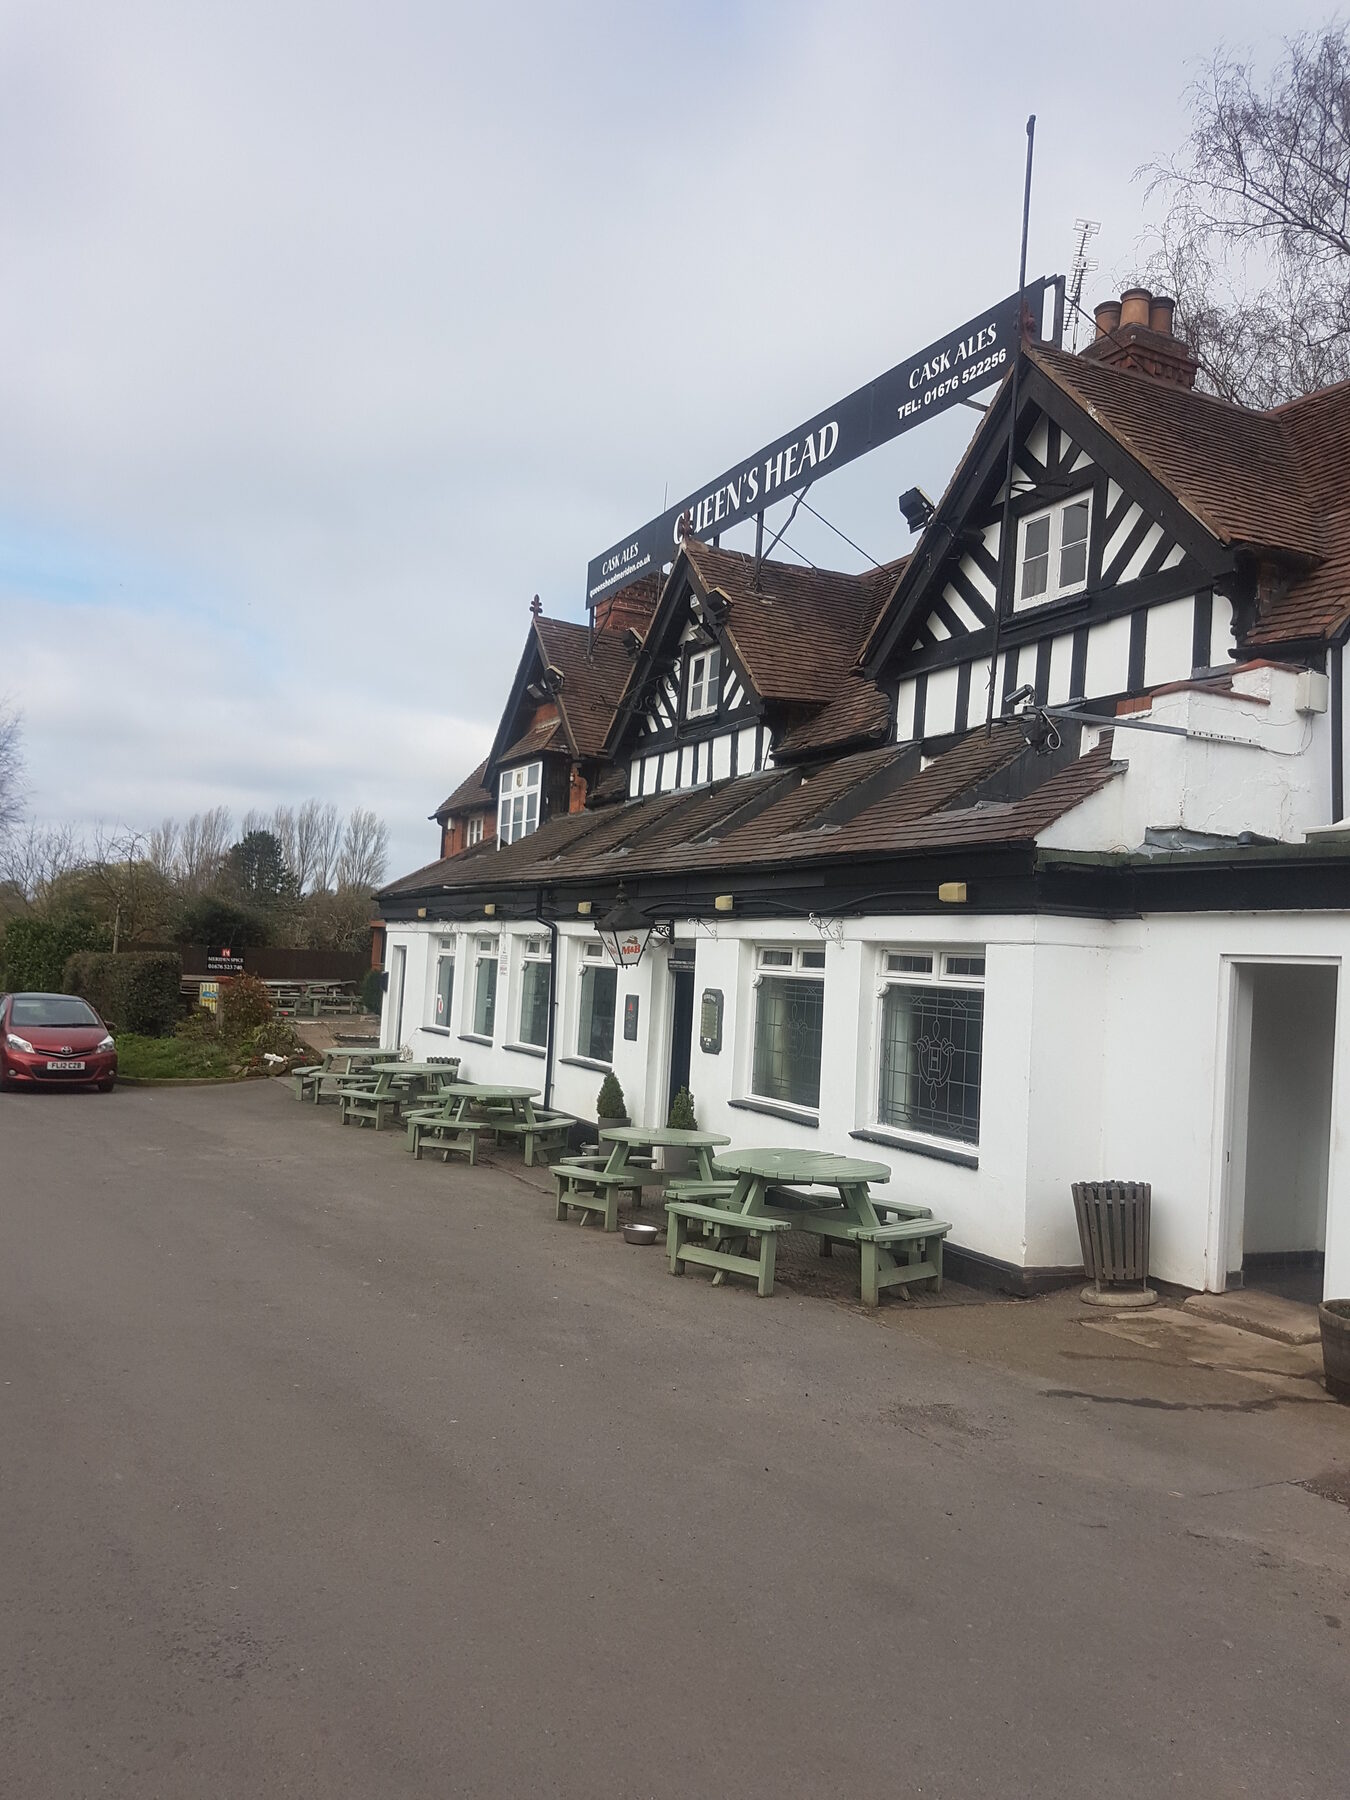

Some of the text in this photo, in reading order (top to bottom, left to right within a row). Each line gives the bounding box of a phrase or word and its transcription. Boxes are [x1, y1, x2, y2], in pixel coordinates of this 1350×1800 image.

[897, 348, 1007, 420] TEL: 01676 522256
[909, 323, 997, 389] CASK ALES
[764, 421, 839, 494] HEAD
[602, 542, 638, 575] CASK ALES
[622, 944, 640, 954] M&B
